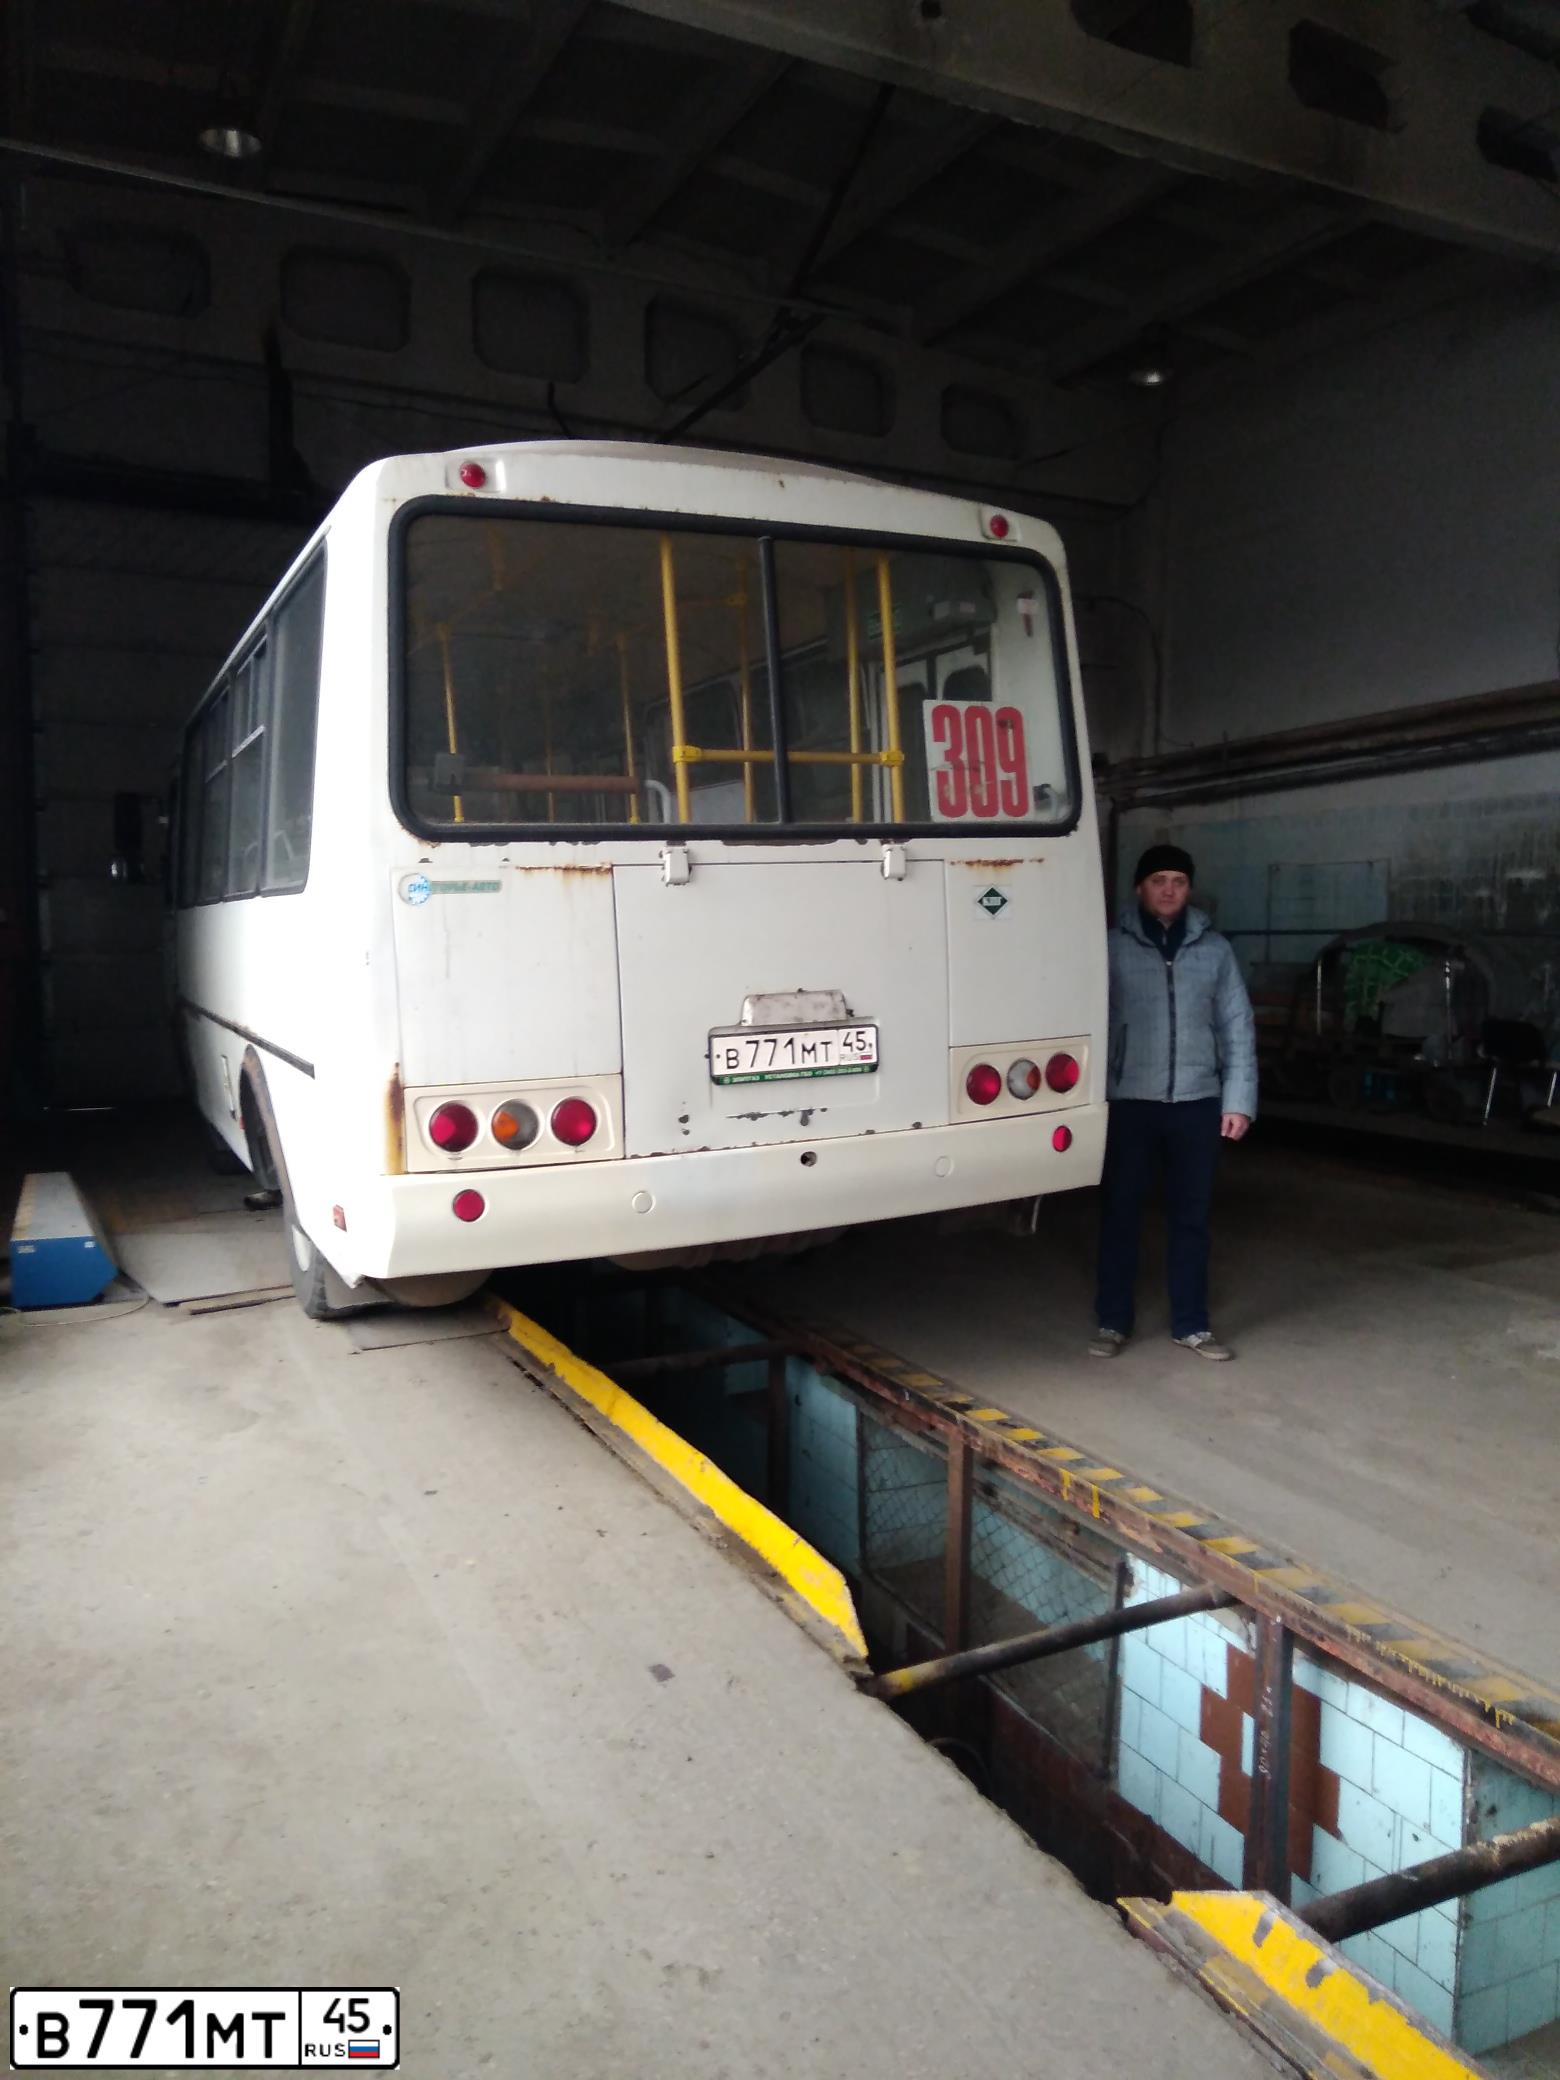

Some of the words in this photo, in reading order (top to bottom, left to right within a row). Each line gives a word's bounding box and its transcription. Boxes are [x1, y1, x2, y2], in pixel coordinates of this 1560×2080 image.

[931, 704, 1029, 818] 309
[725, 1037, 832, 1069] В771МТ
[843, 1031, 866, 1052] 45
